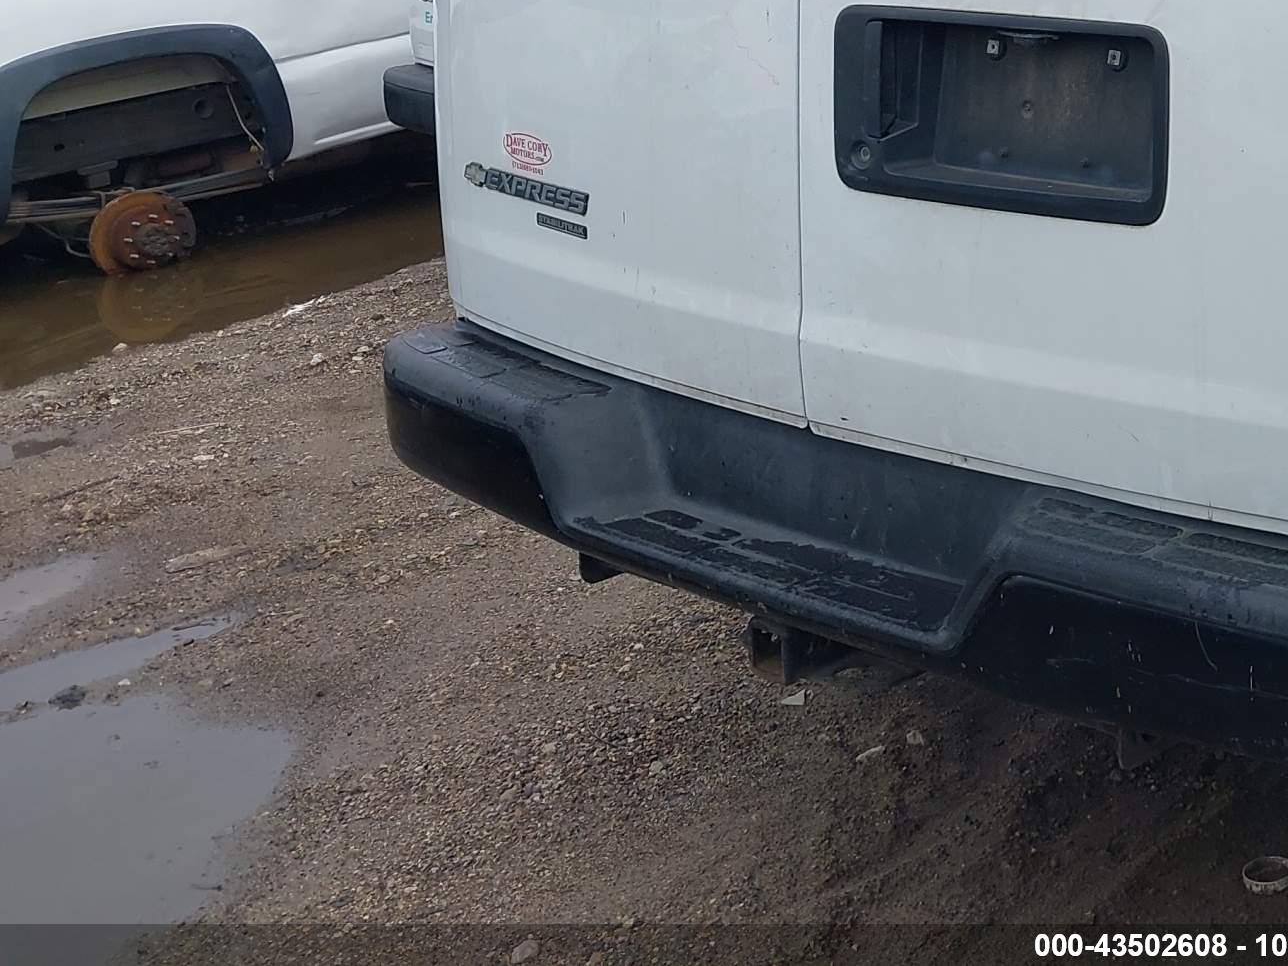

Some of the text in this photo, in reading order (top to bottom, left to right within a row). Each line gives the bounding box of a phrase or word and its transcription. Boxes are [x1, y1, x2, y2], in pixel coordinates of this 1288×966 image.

[505, 133, 548, 157] DAVE CORY
[485, 169, 588, 215] EXPRESS
